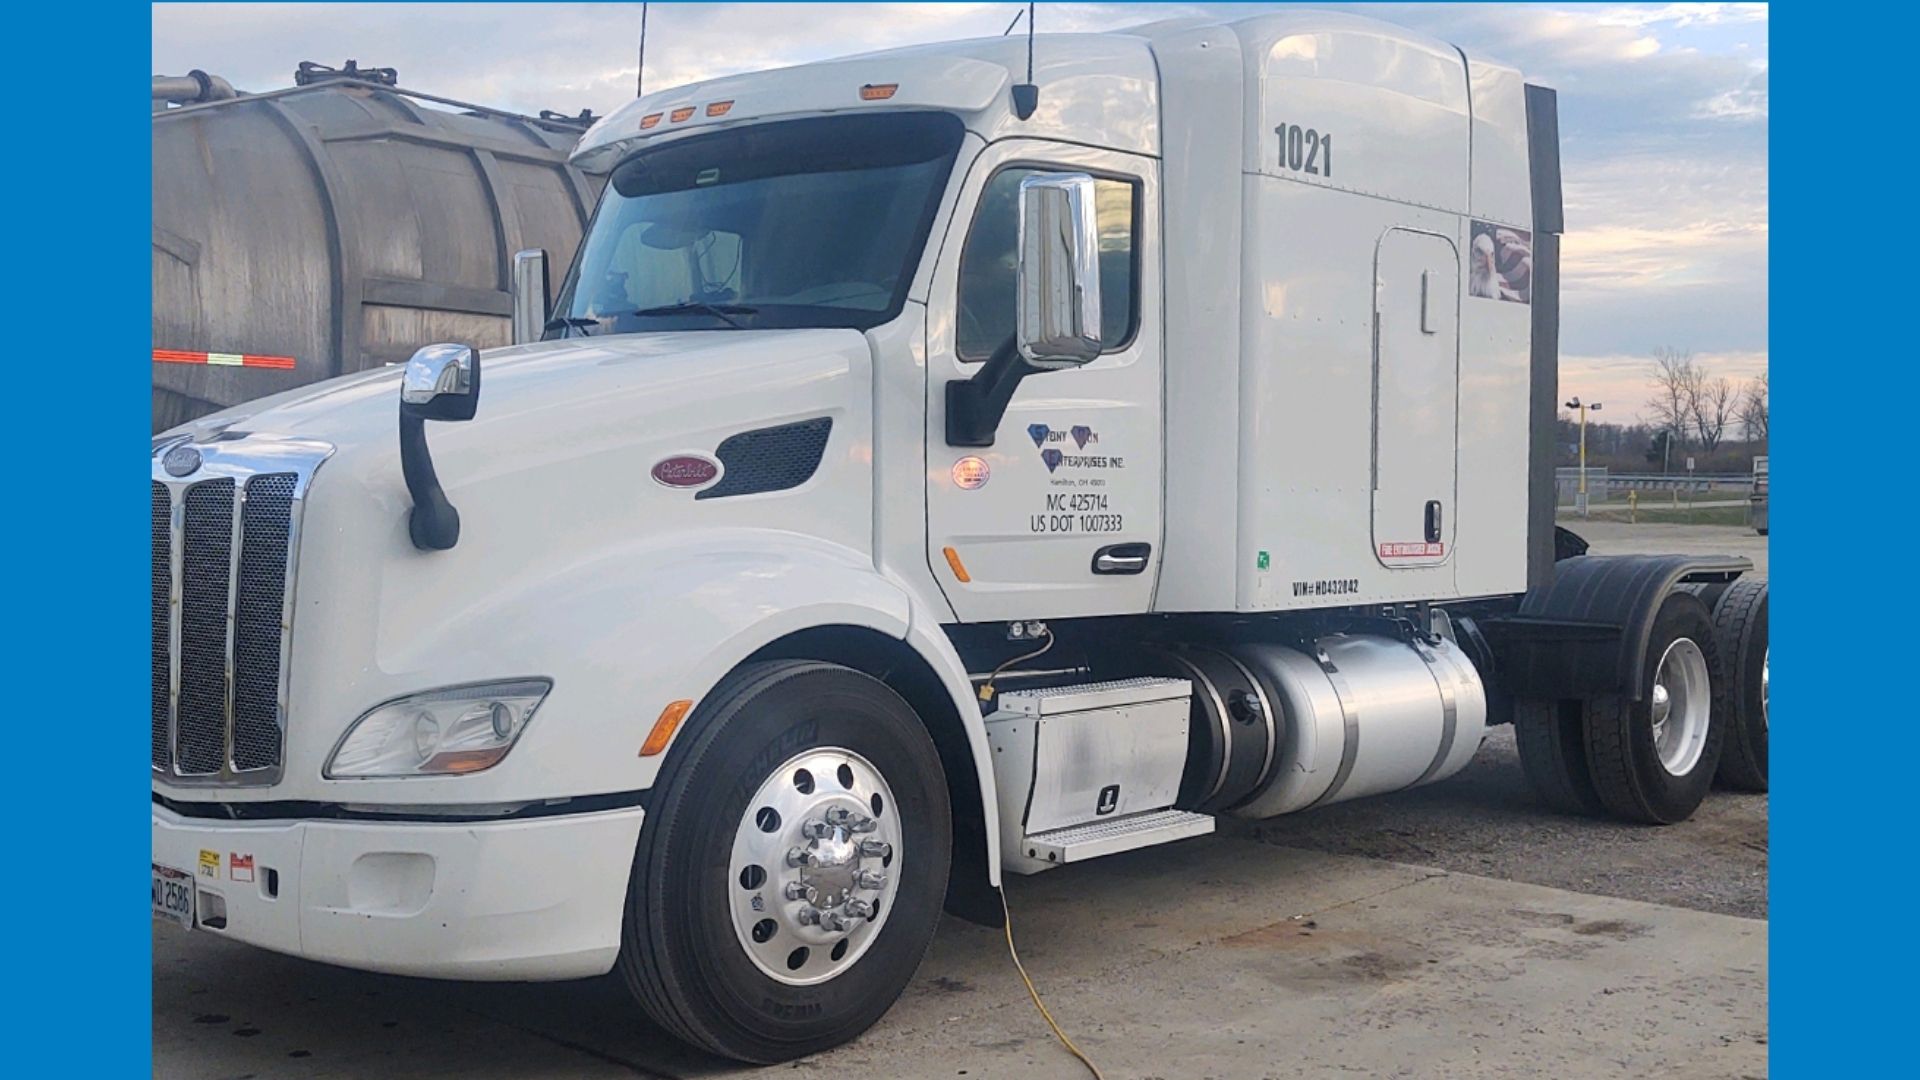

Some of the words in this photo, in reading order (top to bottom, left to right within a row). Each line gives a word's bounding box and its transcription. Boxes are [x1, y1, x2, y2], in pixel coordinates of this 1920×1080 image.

[1274, 122, 1331, 177] 1021
[1047, 493, 1067, 511] MC
[1069, 493, 1108, 511] 425714
[1031, 514, 1046, 532] US
[1050, 514, 1075, 532] DOT
[1079, 514, 1123, 532] 1007333
[165, 881, 190, 915] 2586
